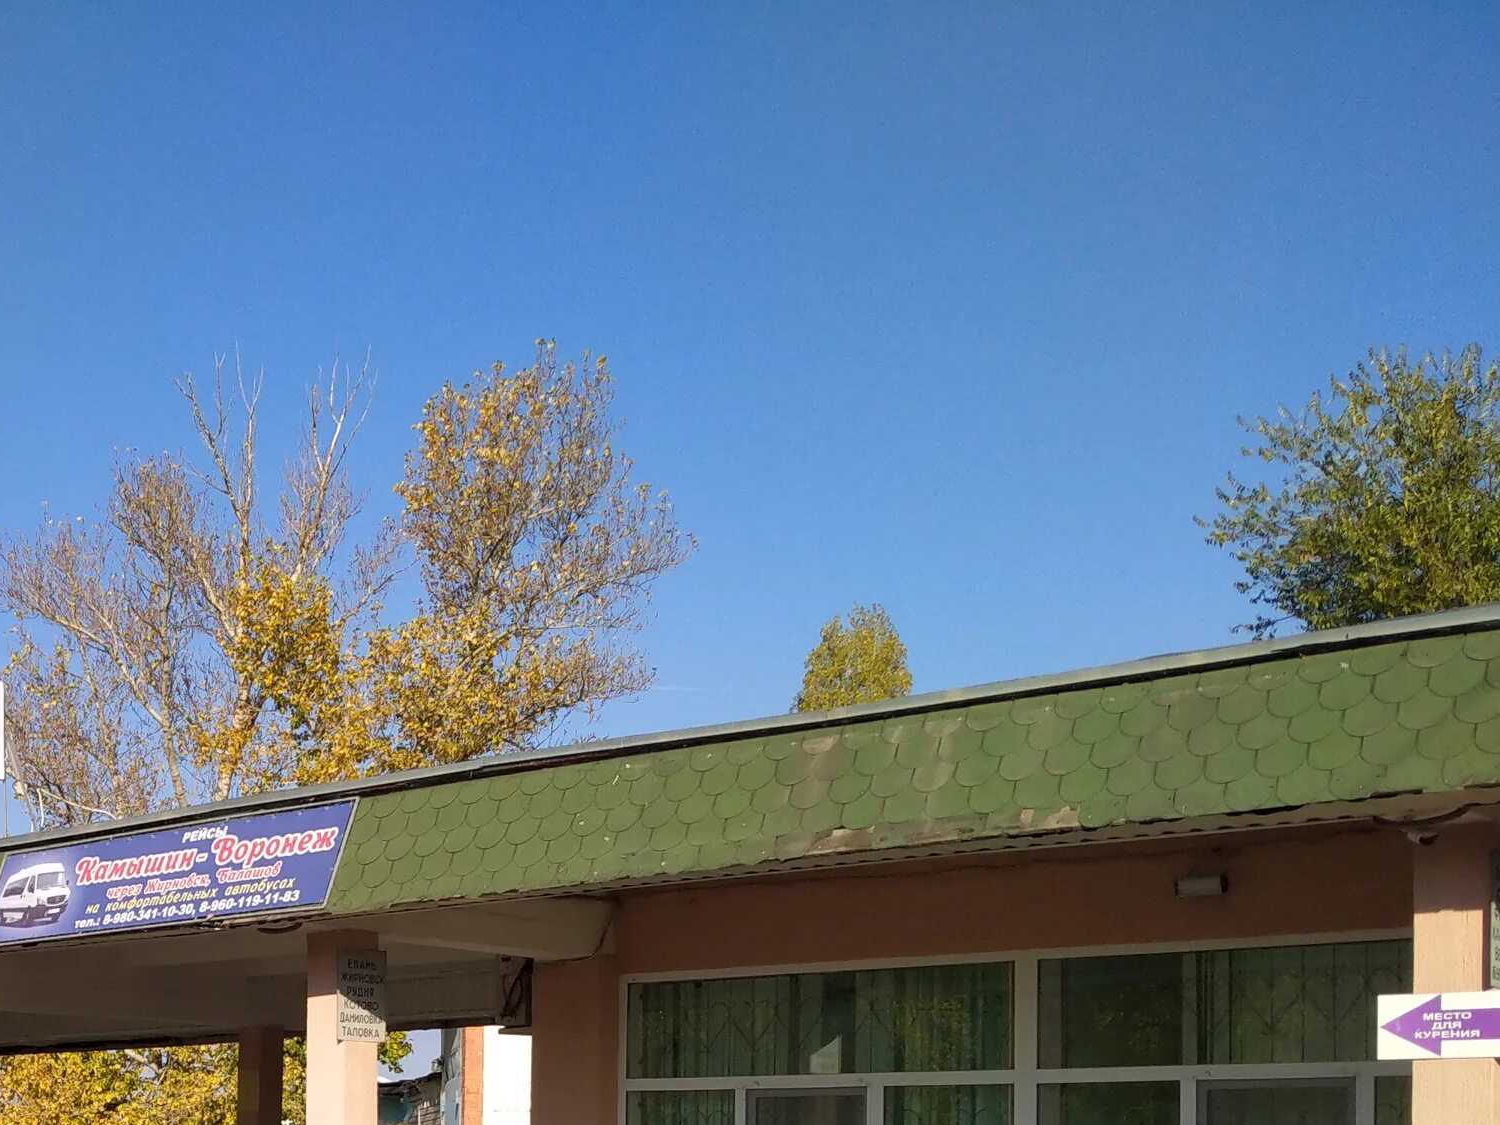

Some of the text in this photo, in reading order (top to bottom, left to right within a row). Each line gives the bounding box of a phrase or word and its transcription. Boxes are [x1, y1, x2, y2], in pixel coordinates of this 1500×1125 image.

[182, 826, 228, 843] РЕЙСЫ
[212, 827, 338, 868] Воронеж
[106, 883, 142, 900] через
[216, 861, 282, 883] Балашов
[85, 877, 296, 915] на комфортабельных автобусах
[199, 890, 300, 913] 8-960-119-11-83
[343, 999, 379, 1011] КОТОВО
[340, 1012, 383, 1024] ДАНИЛОВКА
[1422, 1012, 1472, 1021] МЕСТО
[1431, 1021, 1462, 1030] ДЛЯ
[341, 1026, 380, 1038] ТАЛОВКА
[1414, 1029, 1481, 1039] КУРЕНИЯ
